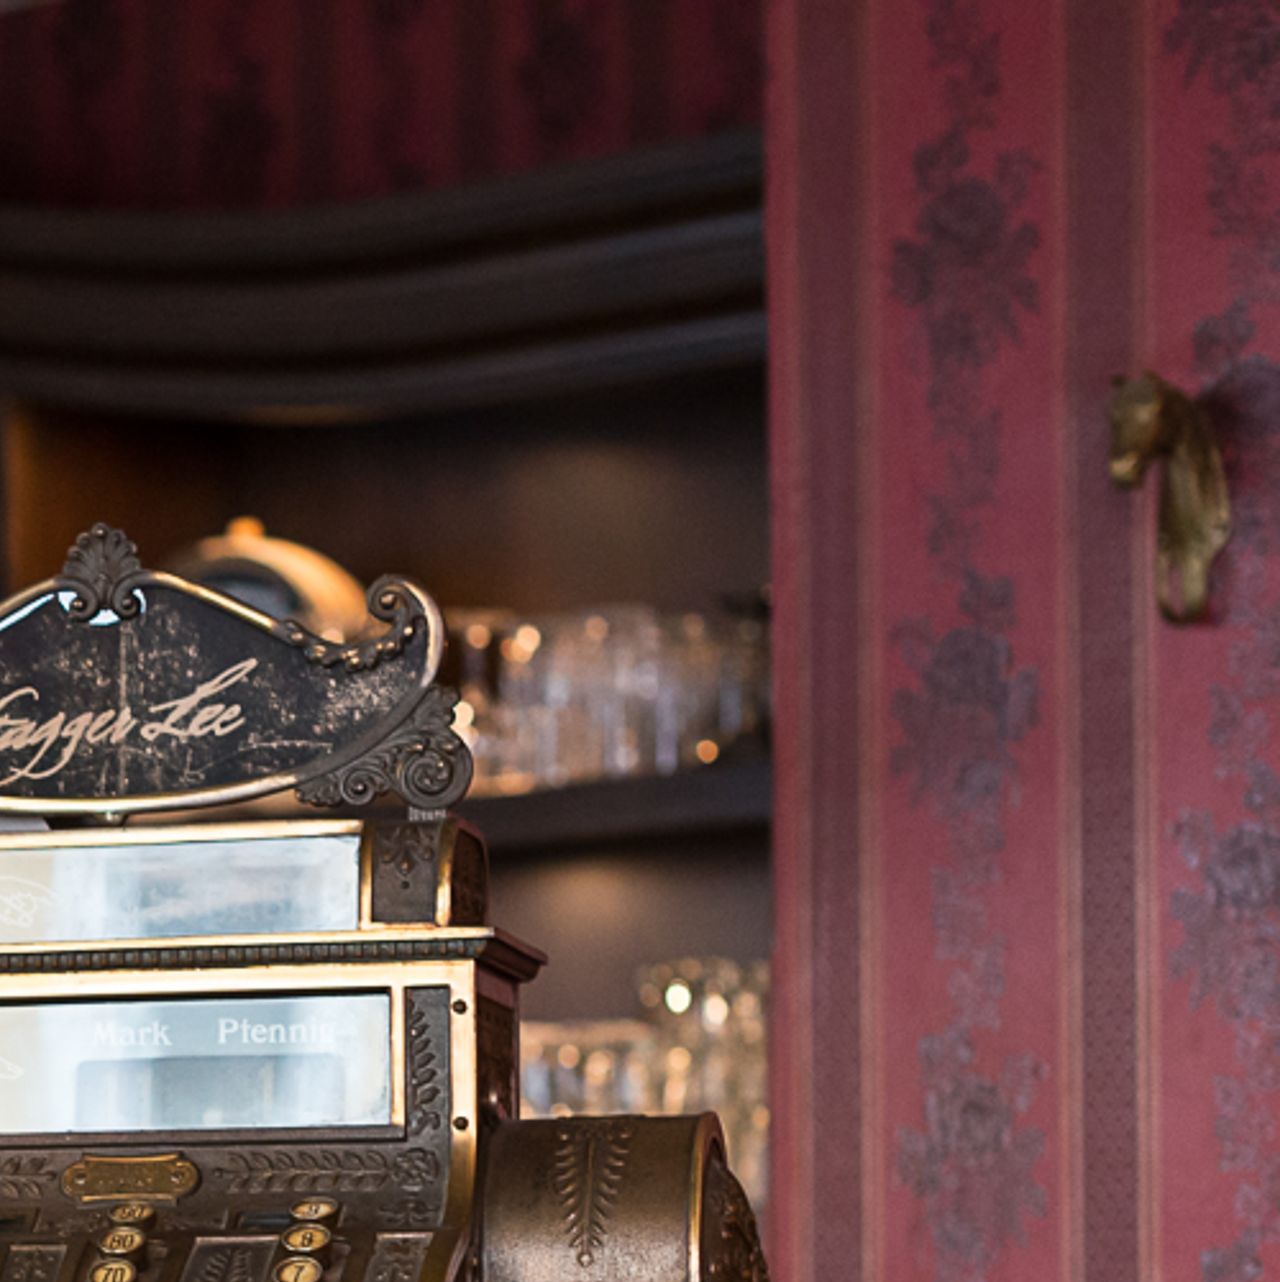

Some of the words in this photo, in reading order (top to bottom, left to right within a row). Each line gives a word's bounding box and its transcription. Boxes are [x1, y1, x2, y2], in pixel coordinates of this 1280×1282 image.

[141, 658, 258, 739] Lee
[92, 1020, 173, 1046] Mark
[109, 1233, 135, 1249] 80
[299, 1231, 313, 1247] 8
